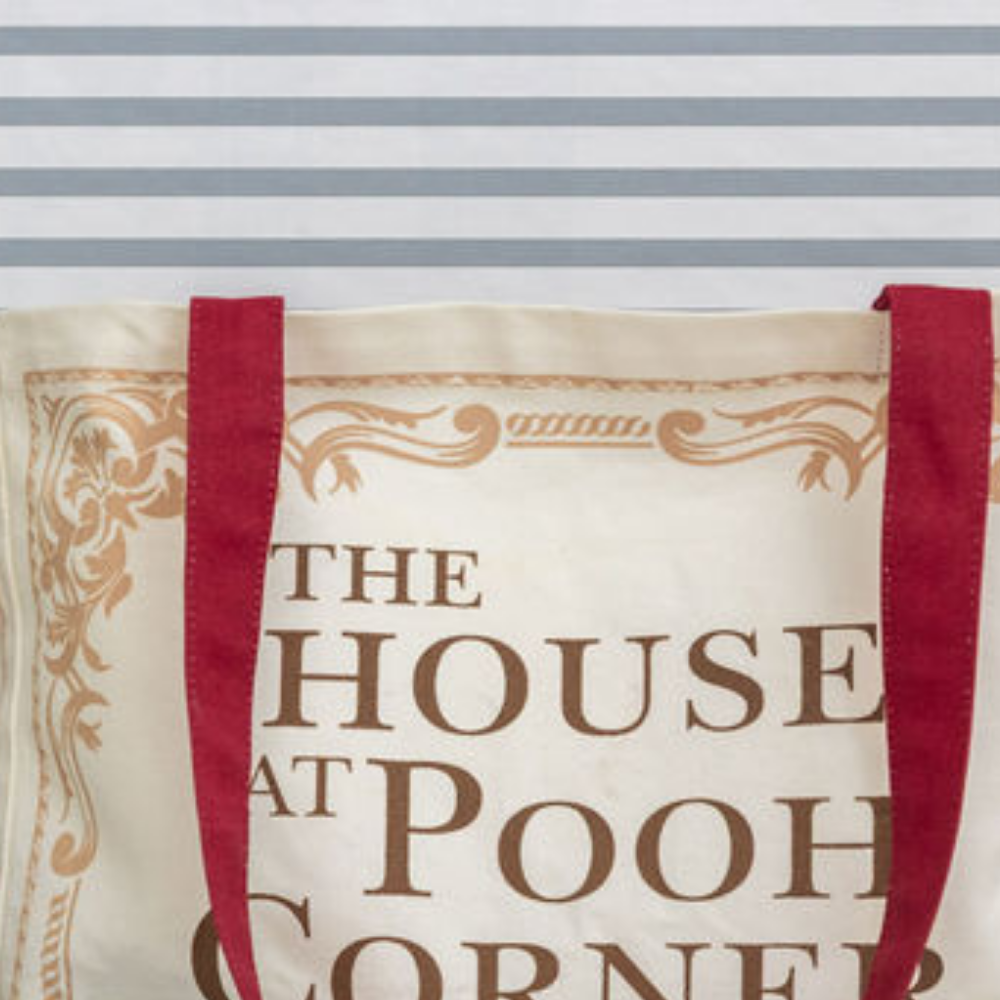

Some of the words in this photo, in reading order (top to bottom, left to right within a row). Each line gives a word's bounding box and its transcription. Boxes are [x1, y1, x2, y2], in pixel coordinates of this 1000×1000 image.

[271, 543, 481, 608] THE
[261, 623, 885, 736] HOUSE
[248, 755, 353, 817] AT
[362, 757, 893, 903] POOH
